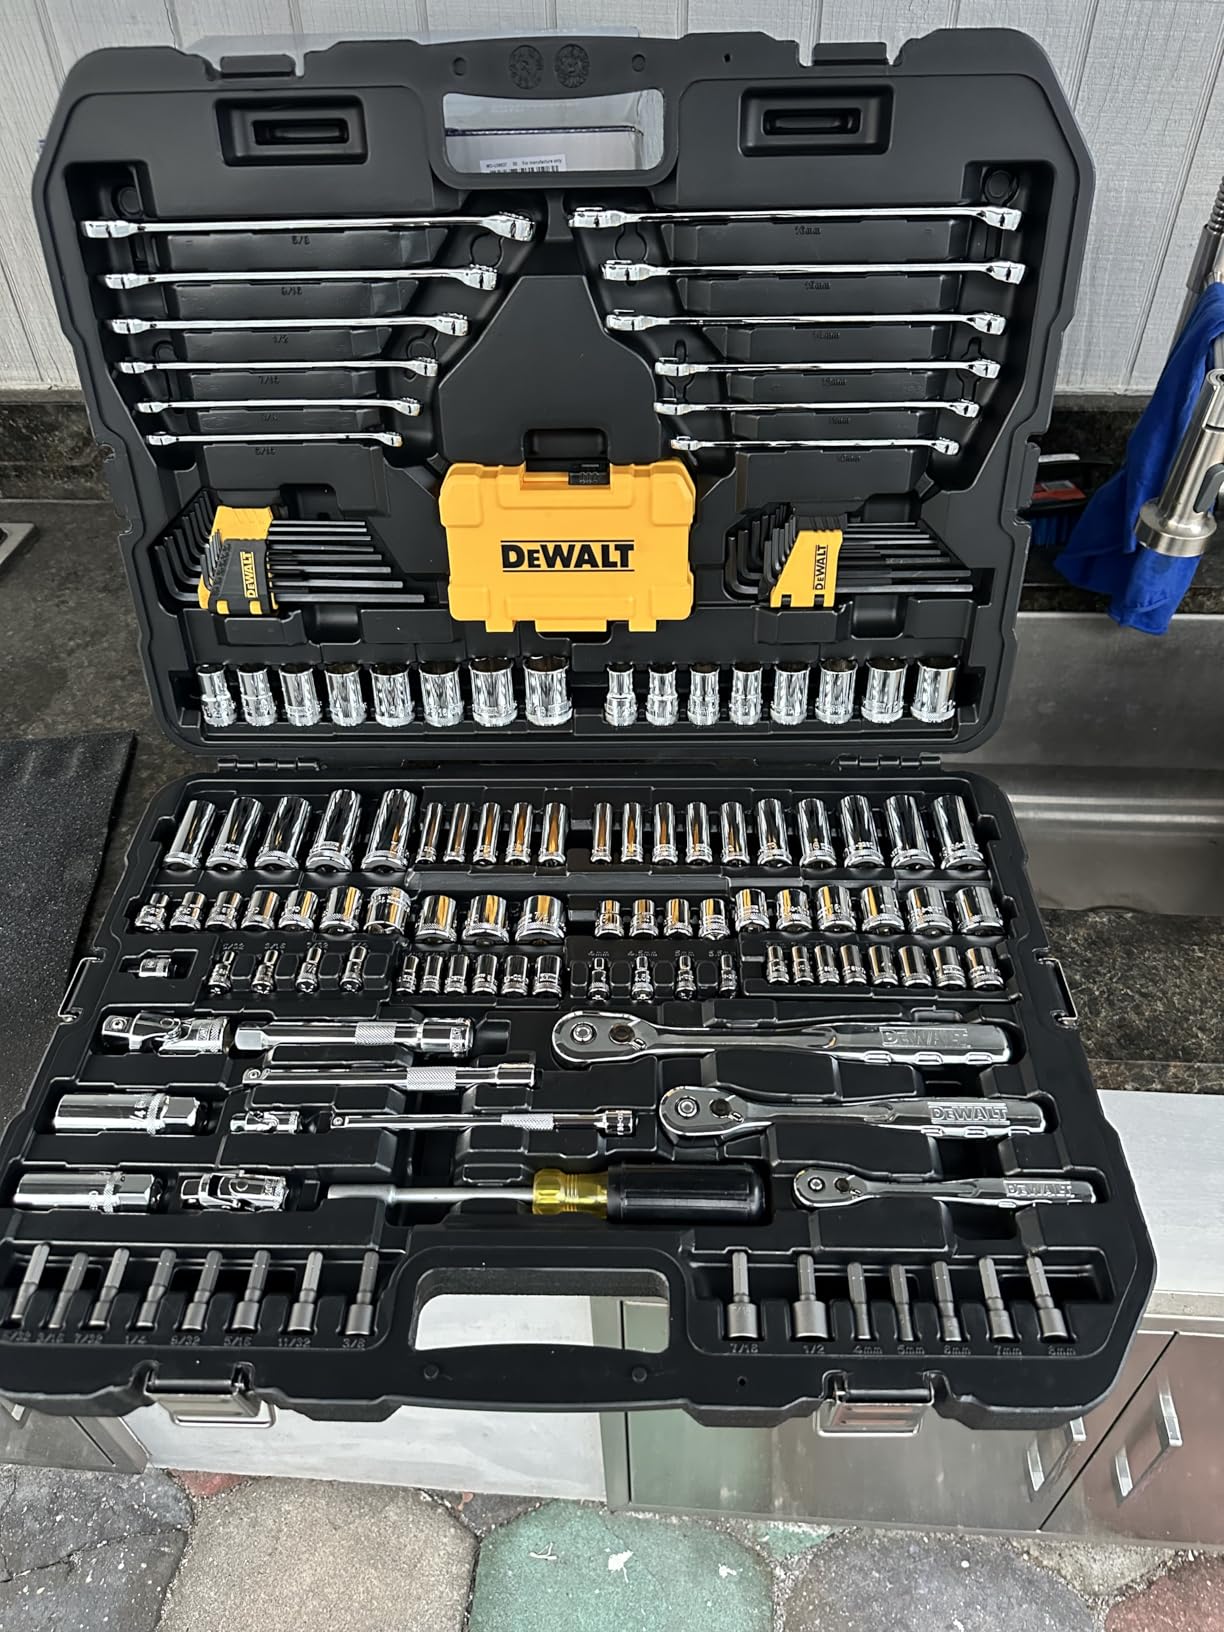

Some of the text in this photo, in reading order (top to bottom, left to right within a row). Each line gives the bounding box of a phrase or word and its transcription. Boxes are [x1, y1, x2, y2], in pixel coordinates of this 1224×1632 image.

[501, 544, 634, 568] DEWALT
[242, 552, 256, 598] DEWALT
[815, 545, 827, 590] DEWALT
[882, 1029, 969, 1047] DEWALT
[932, 1106, 1009, 1122] DEWALT
[1008, 1183, 1075, 1198] DEWALT
